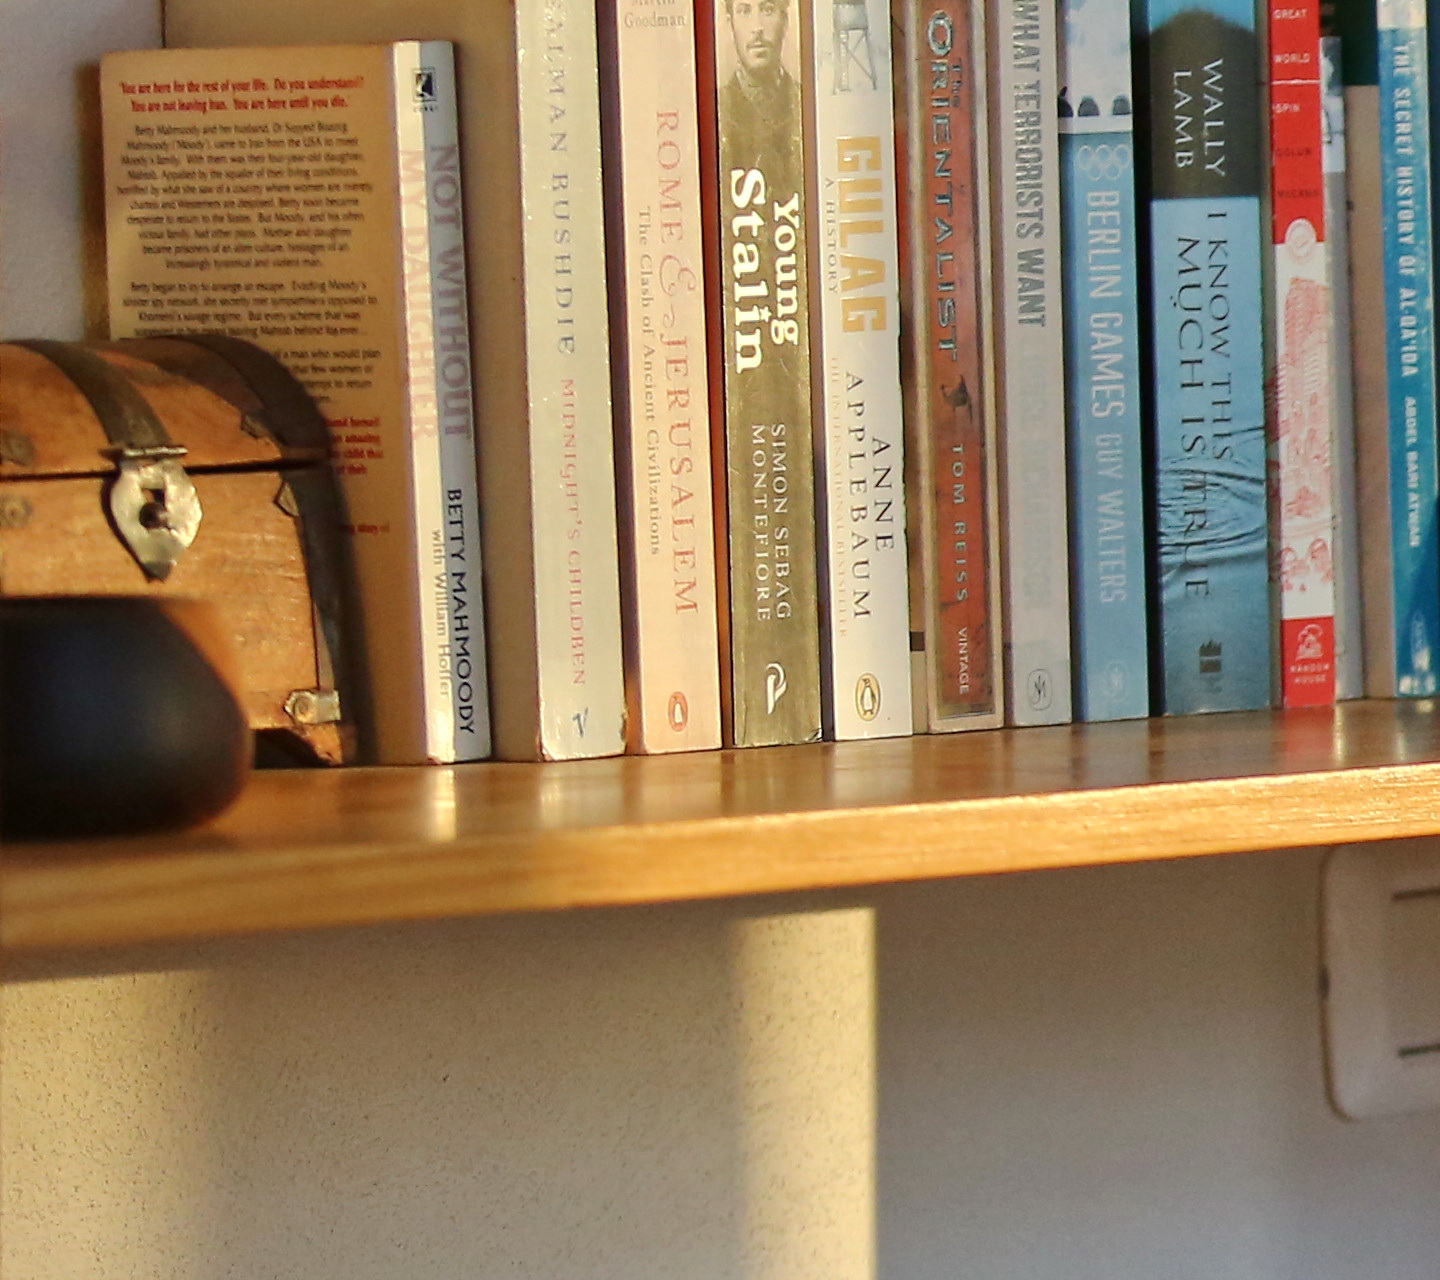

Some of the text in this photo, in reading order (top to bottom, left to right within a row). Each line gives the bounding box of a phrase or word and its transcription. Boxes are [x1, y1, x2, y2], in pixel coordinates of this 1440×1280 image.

[623, 11, 686, 29] Goodman
[951, 58, 964, 108] The
[1272, 8, 1308, 19] GREAT
[1273, 53, 1311, 64] WORLD
[1392, 44, 1412, 76] THE
[656, 110, 684, 245] ROME
[926, 9, 959, 361] ORIENTALIST
[1013, 80, 1045, 241] TERRORISTS
[1172, 70, 1195, 169] LAMB
[1201, 57, 1227, 178] WALLY
[1393, 86, 1413, 156] SECRET
[551, 172, 576, 356] RUSHDIE
[729, 167, 772, 375] Stalin
[770, 191, 800, 346] Young
[824, 176, 840, 296] A HISTORY
[835, 135, 888, 334] GULAG
[1396, 165, 1416, 246] HISTORY
[1397, 254, 1417, 276] OF
[431, 145, 471, 440] NOT WITHOUT
[1016, 248, 1046, 328] WANT
[1207, 239, 1232, 359] KNOW
[638, 205, 663, 556] The Clash of Ancient Civilizations
[1086, 190, 1128, 605] BERLIN GAMES GUY WALTERS
[1176, 236, 1210, 601] MUCH IS TRUE
[1210, 372, 1234, 461] THIS
[558, 377, 587, 686] MIDNIGHT'S CHILDREN
[659, 333, 700, 615] JERUSALEM
[751, 423, 771, 622] MONTEFIORE
[770, 423, 792, 619] SIMON SEBAG
[845, 371, 872, 620] APPLEBAUM
[871, 437, 895, 553] ANNE
[951, 442, 970, 604] TOM REISS
[431, 528, 452, 698] with William Hoffer
[447, 488, 475, 735] BETTY MAHMOODY
[956, 626, 970, 695] VINTAGE
